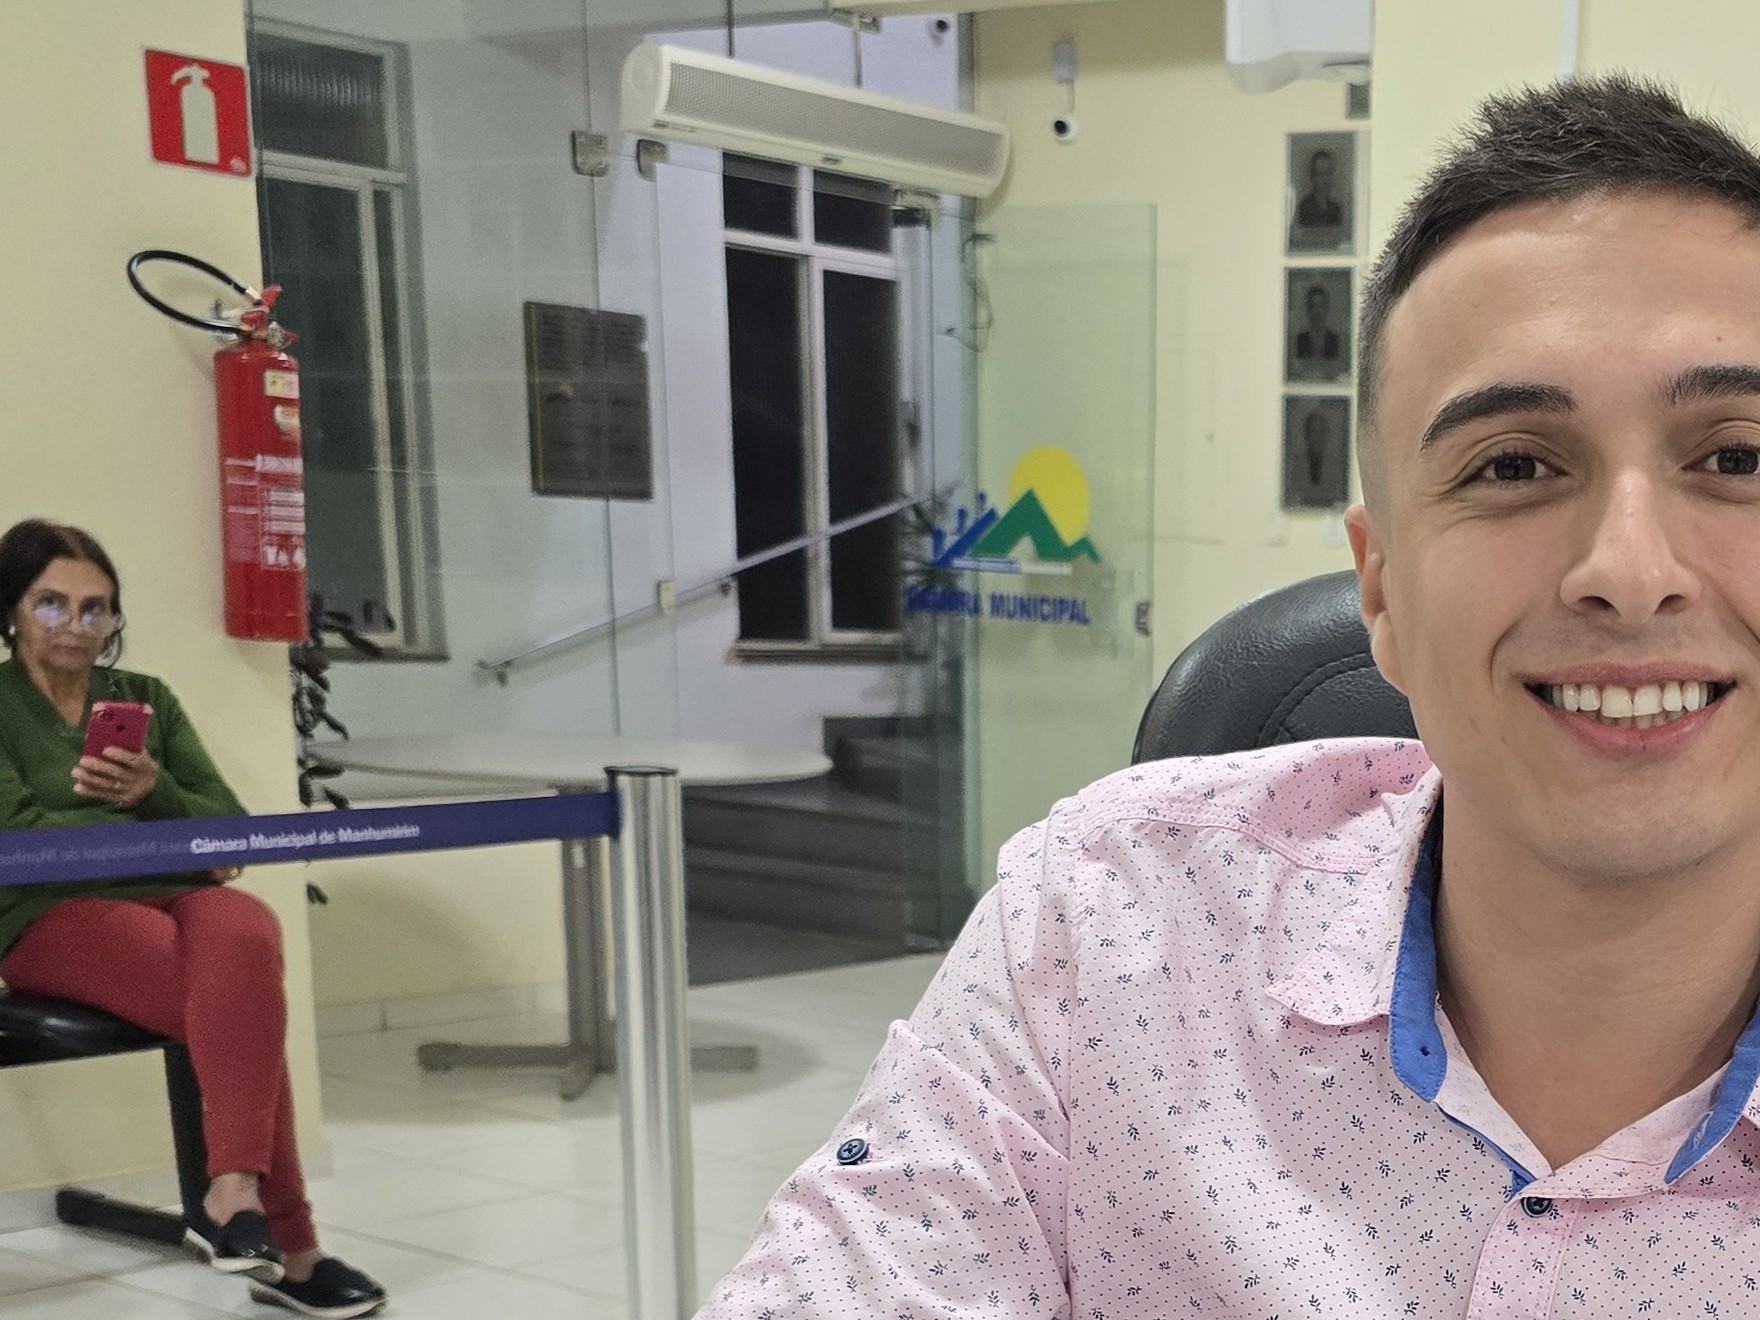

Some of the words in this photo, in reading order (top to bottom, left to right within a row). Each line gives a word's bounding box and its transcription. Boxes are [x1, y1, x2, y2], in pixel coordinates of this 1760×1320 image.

[990, 592, 1090, 626] MUNICIPAL
[190, 836, 247, 853] Câmara
[250, 829, 316, 849] Municipal
[318, 829, 336, 845] de
